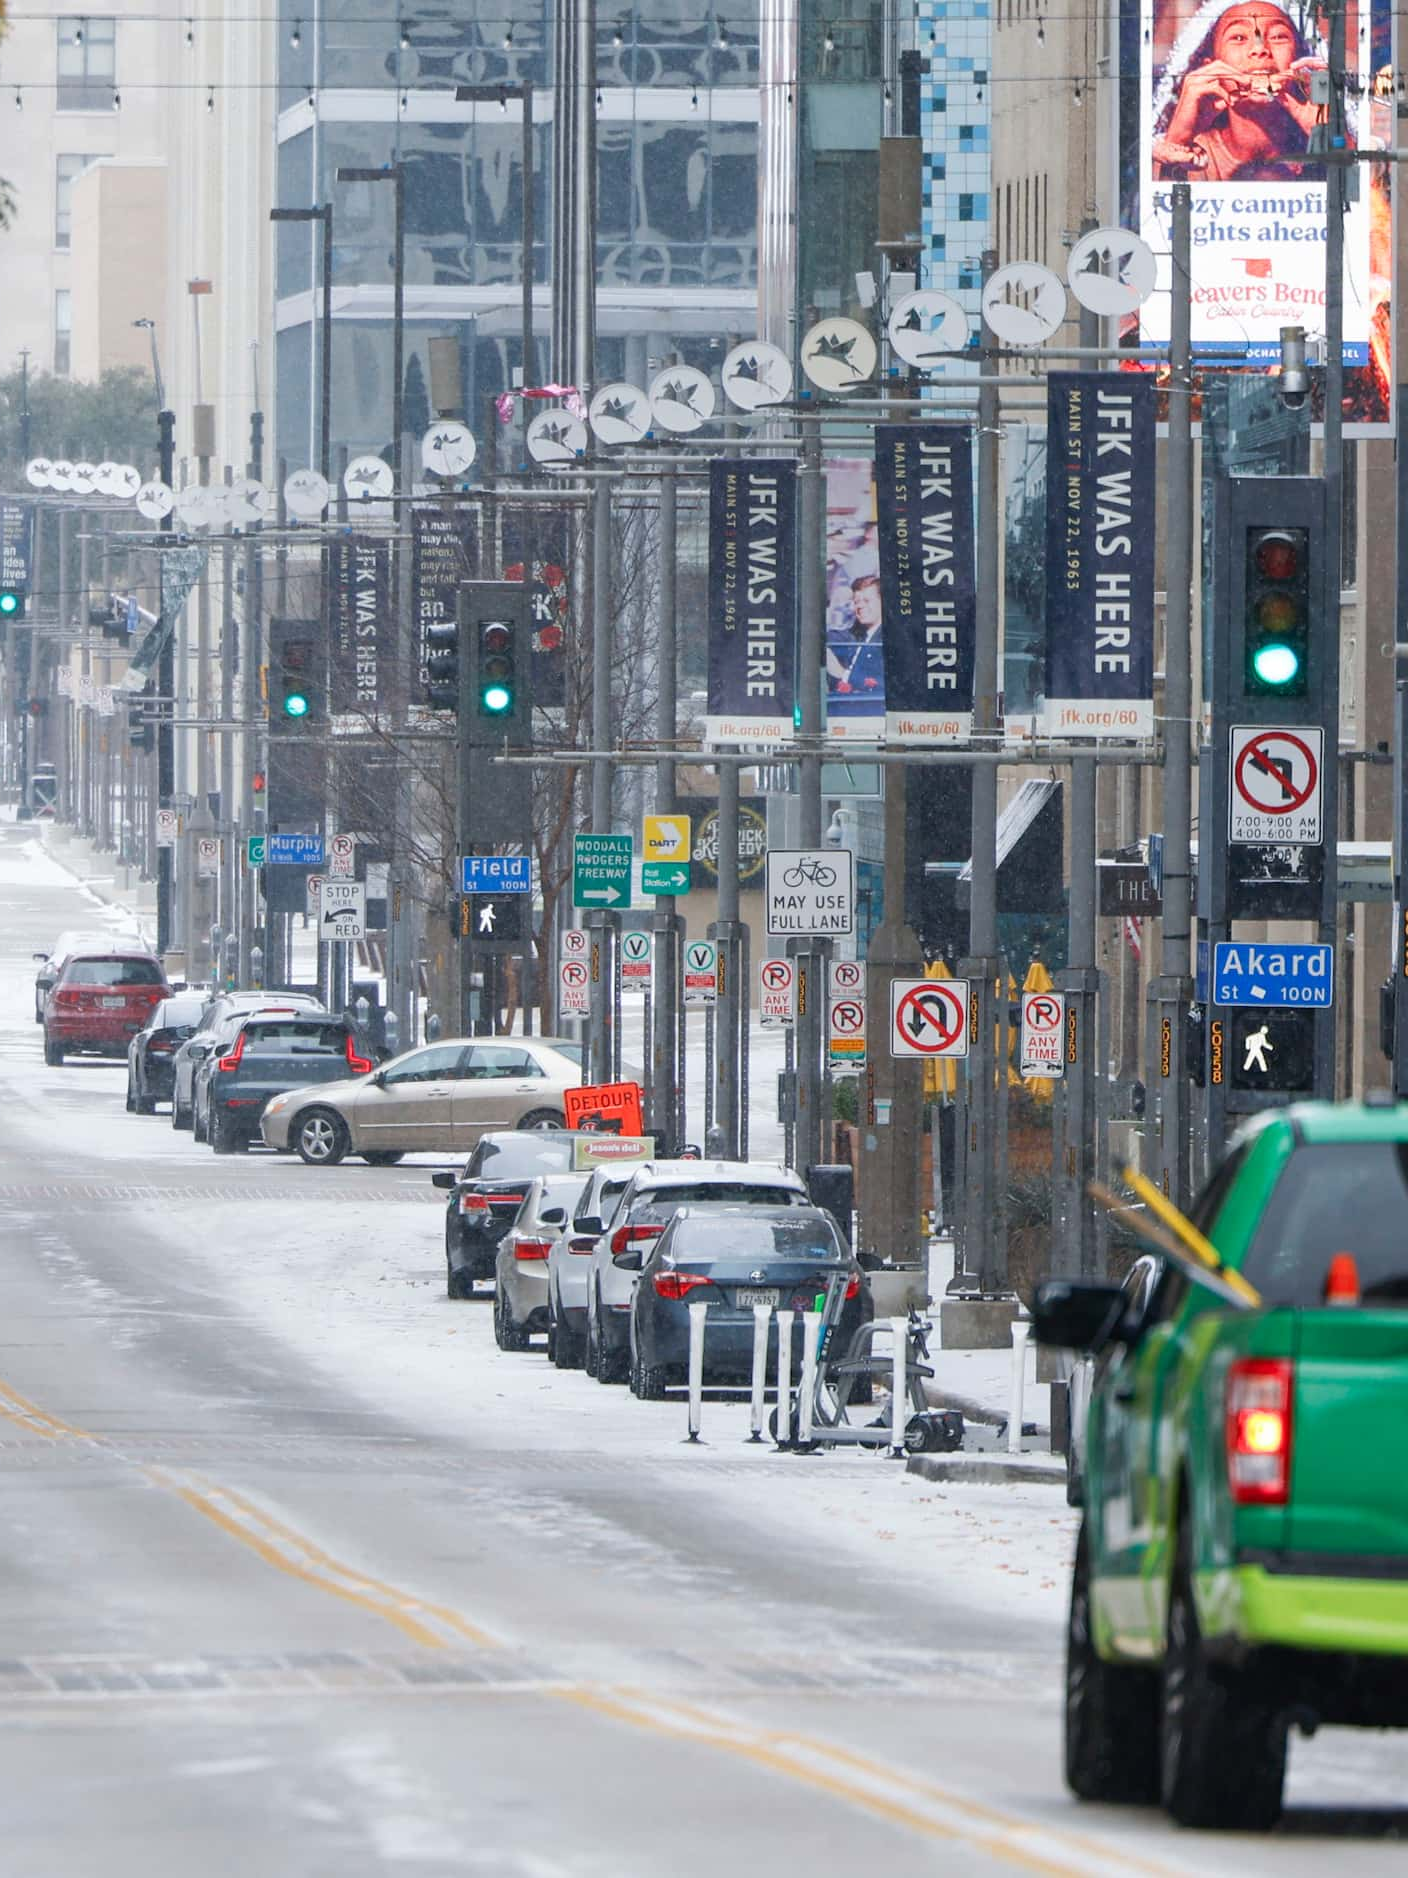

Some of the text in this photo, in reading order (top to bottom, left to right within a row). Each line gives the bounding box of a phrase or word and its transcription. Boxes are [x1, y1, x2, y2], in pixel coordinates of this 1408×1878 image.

[1188, 284, 1267, 304] eavers
[726, 474, 737, 508] MAIN
[1066, 390, 1081, 590] MAIN ST NOV 22, 1963
[726, 512, 737, 528] ST
[894, 442, 912, 616] MAIN ST NOV 22, 1963
[1095, 389, 1132, 674] JFK WAS HERE
[725, 541, 737, 568] NOV
[356, 545, 377, 582] JFK
[919, 441, 957, 690] JFK WAS HERE
[3, 568, 27, 579] lives
[746, 474, 778, 697] JFK WAS HERE
[355, 589, 377, 638] WAS
[420, 600, 445, 617] an
[724, 599, 736, 631] 1963
[355, 645, 378, 701] HERE
[1060, 709, 1138, 727] jfk.org/60
[719, 725, 781, 738] jfk.org/60
[898, 719, 960, 736] jfk.org/60
[1235, 816, 1316, 827] 7:00-9:00 AM
[1235, 828, 1316, 839] 4:00-6:00 PM
[271, 837, 322, 853] Murphy
[575, 840, 632, 851] WOODALL
[649, 839, 678, 847] DART
[471, 860, 522, 876] Field
[576, 855, 629, 866] RODGERS
[578, 868, 628, 879] FREEWAY
[326, 887, 360, 898] STOP
[466, 881, 527, 890] St 100N
[1118, 880, 1149, 901] THE
[774, 895, 845, 909] MAY USE
[335, 924, 360, 936] RED
[771, 915, 848, 929] FULL LANE
[1222, 947, 1326, 977] Akard
[564, 991, 585, 999] ANY
[765, 995, 789, 1004] ANY
[1221, 985, 1326, 1001] St 100N
[563, 1000, 586, 1008] TIME
[763, 1006, 790, 1015] TIME
[1028, 1036, 1058, 1047] ANY
[1026, 1048, 1059, 1059] TIME
[1211, 1021, 1223, 1084] C0358
[570, 1091, 634, 1112] DETOUR
